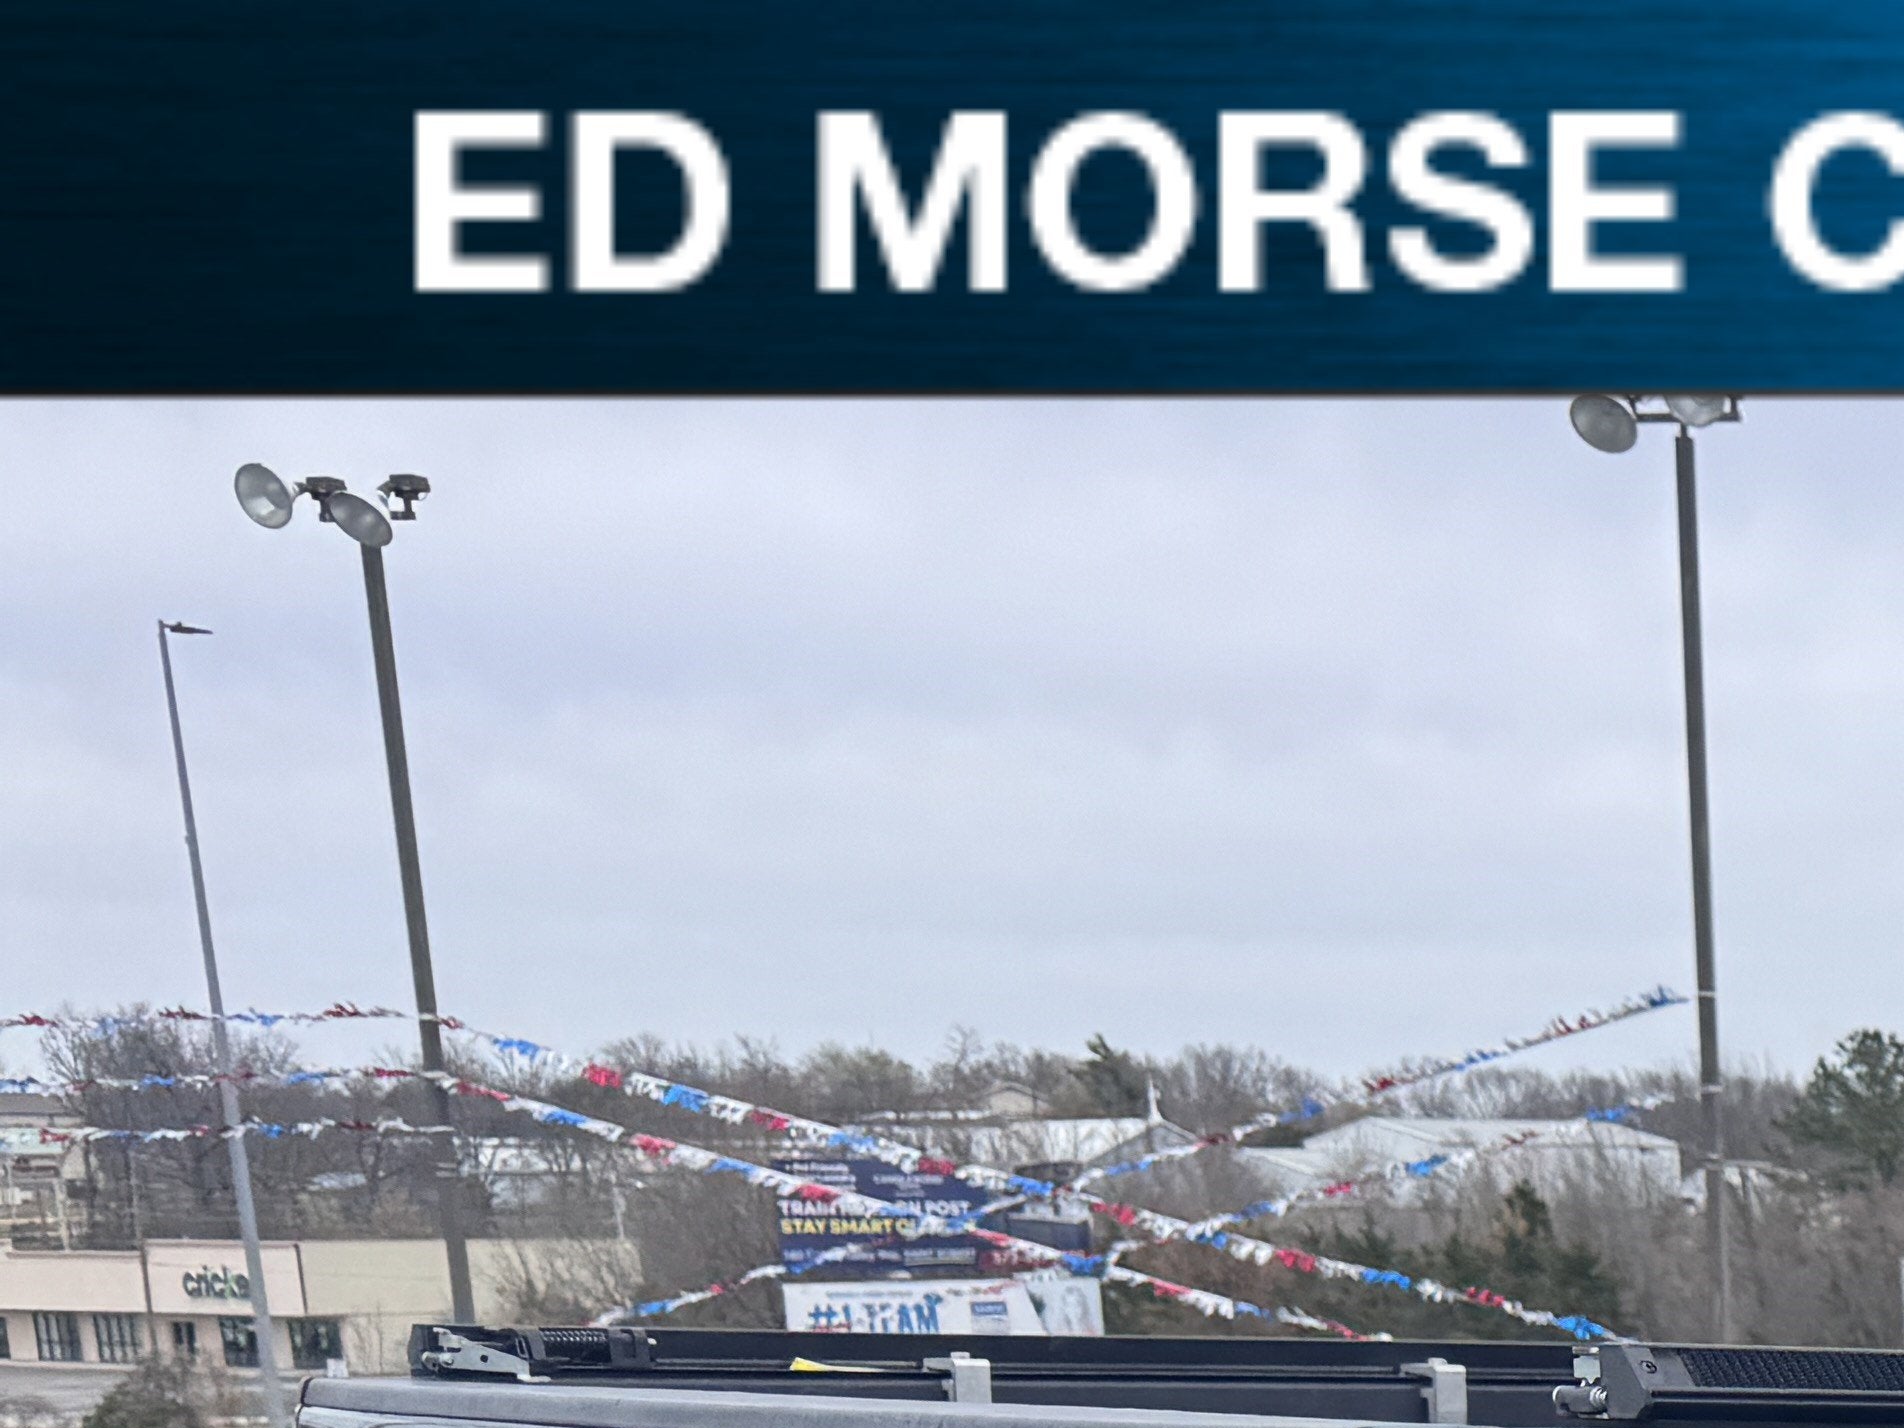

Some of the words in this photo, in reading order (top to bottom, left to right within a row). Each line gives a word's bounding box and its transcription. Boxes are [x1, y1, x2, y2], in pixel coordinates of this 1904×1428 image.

[780, 1218, 827, 1235] STAY
[830, 1218, 894, 1235] SMART
[182, 1264, 249, 1299] cricke
